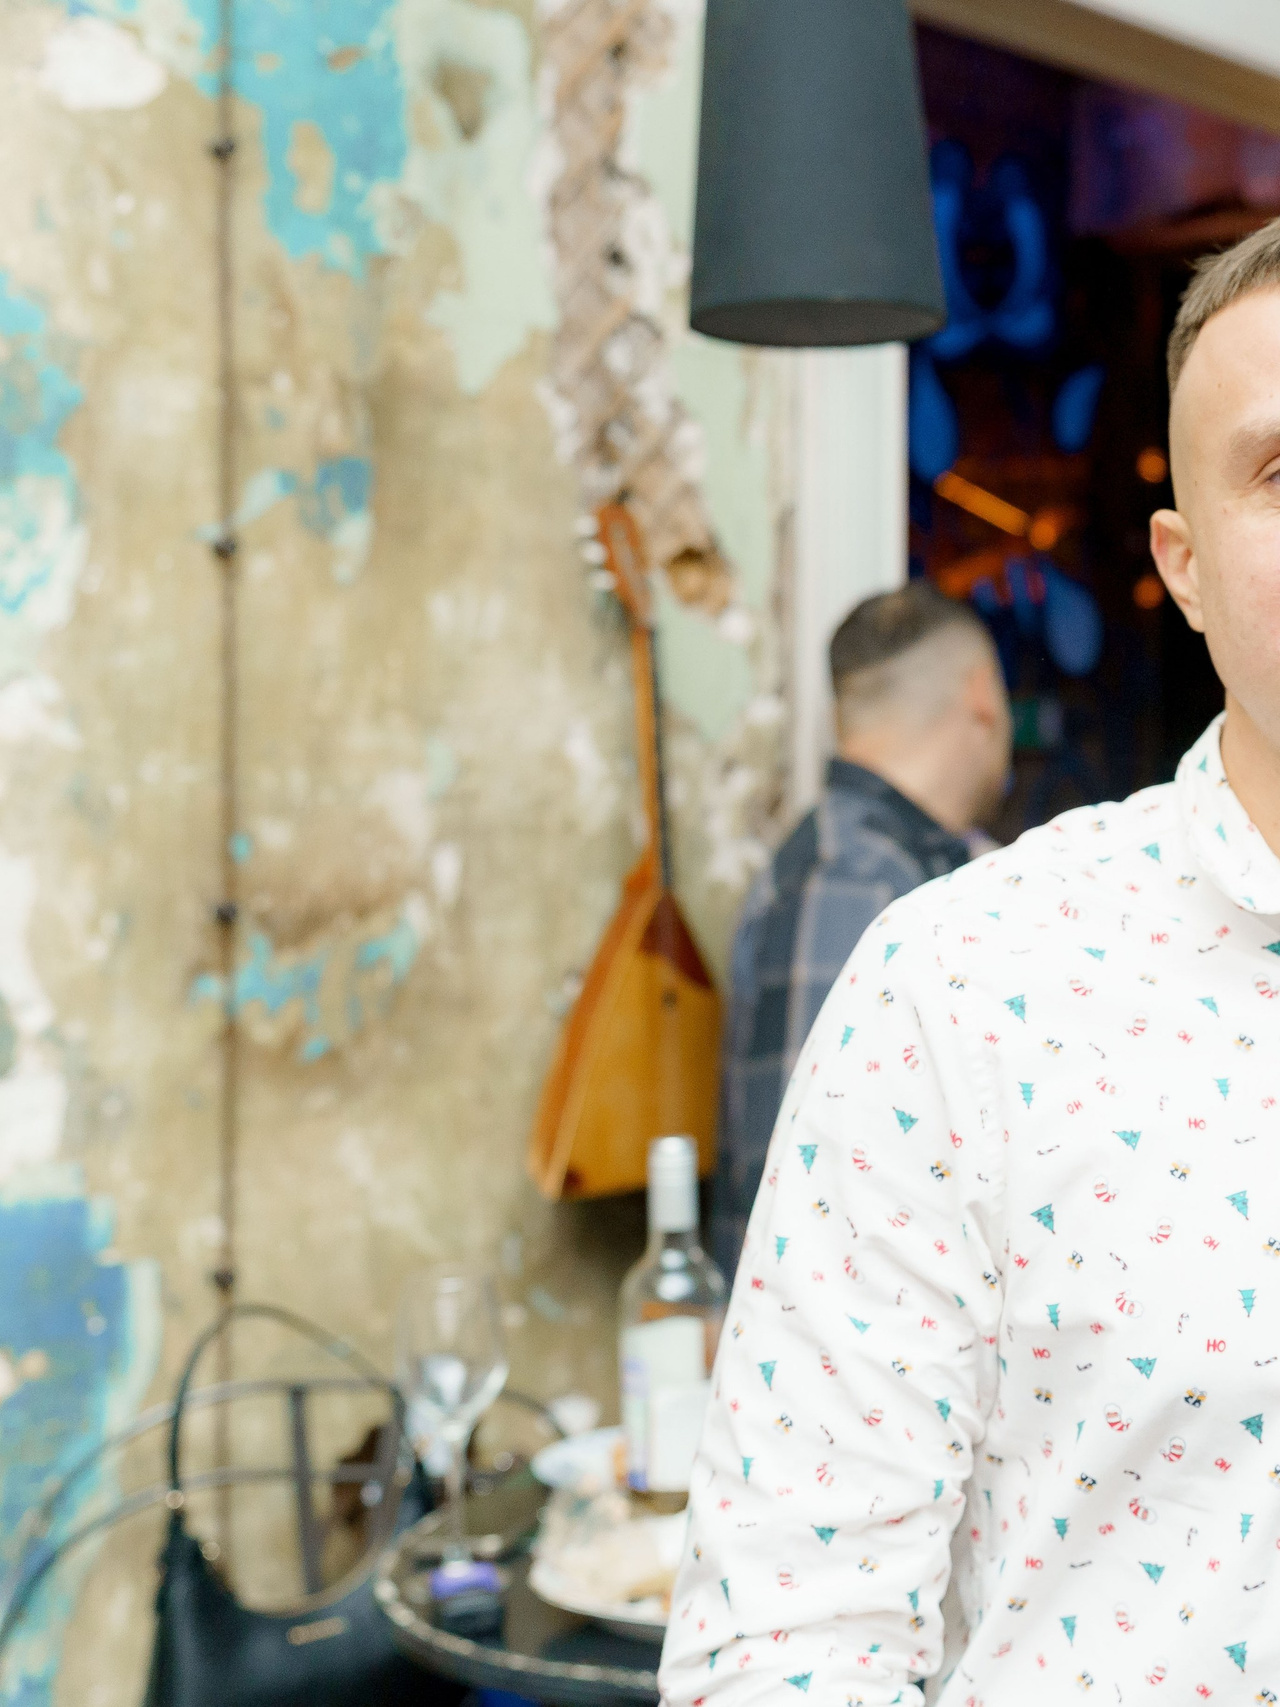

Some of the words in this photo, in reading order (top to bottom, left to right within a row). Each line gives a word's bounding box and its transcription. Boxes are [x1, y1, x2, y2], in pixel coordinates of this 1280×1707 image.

[1188, 1118, 1205, 1130] HO
[1206, 1339, 1226, 1352] HO
[1025, 1558, 1042, 1569] HO
